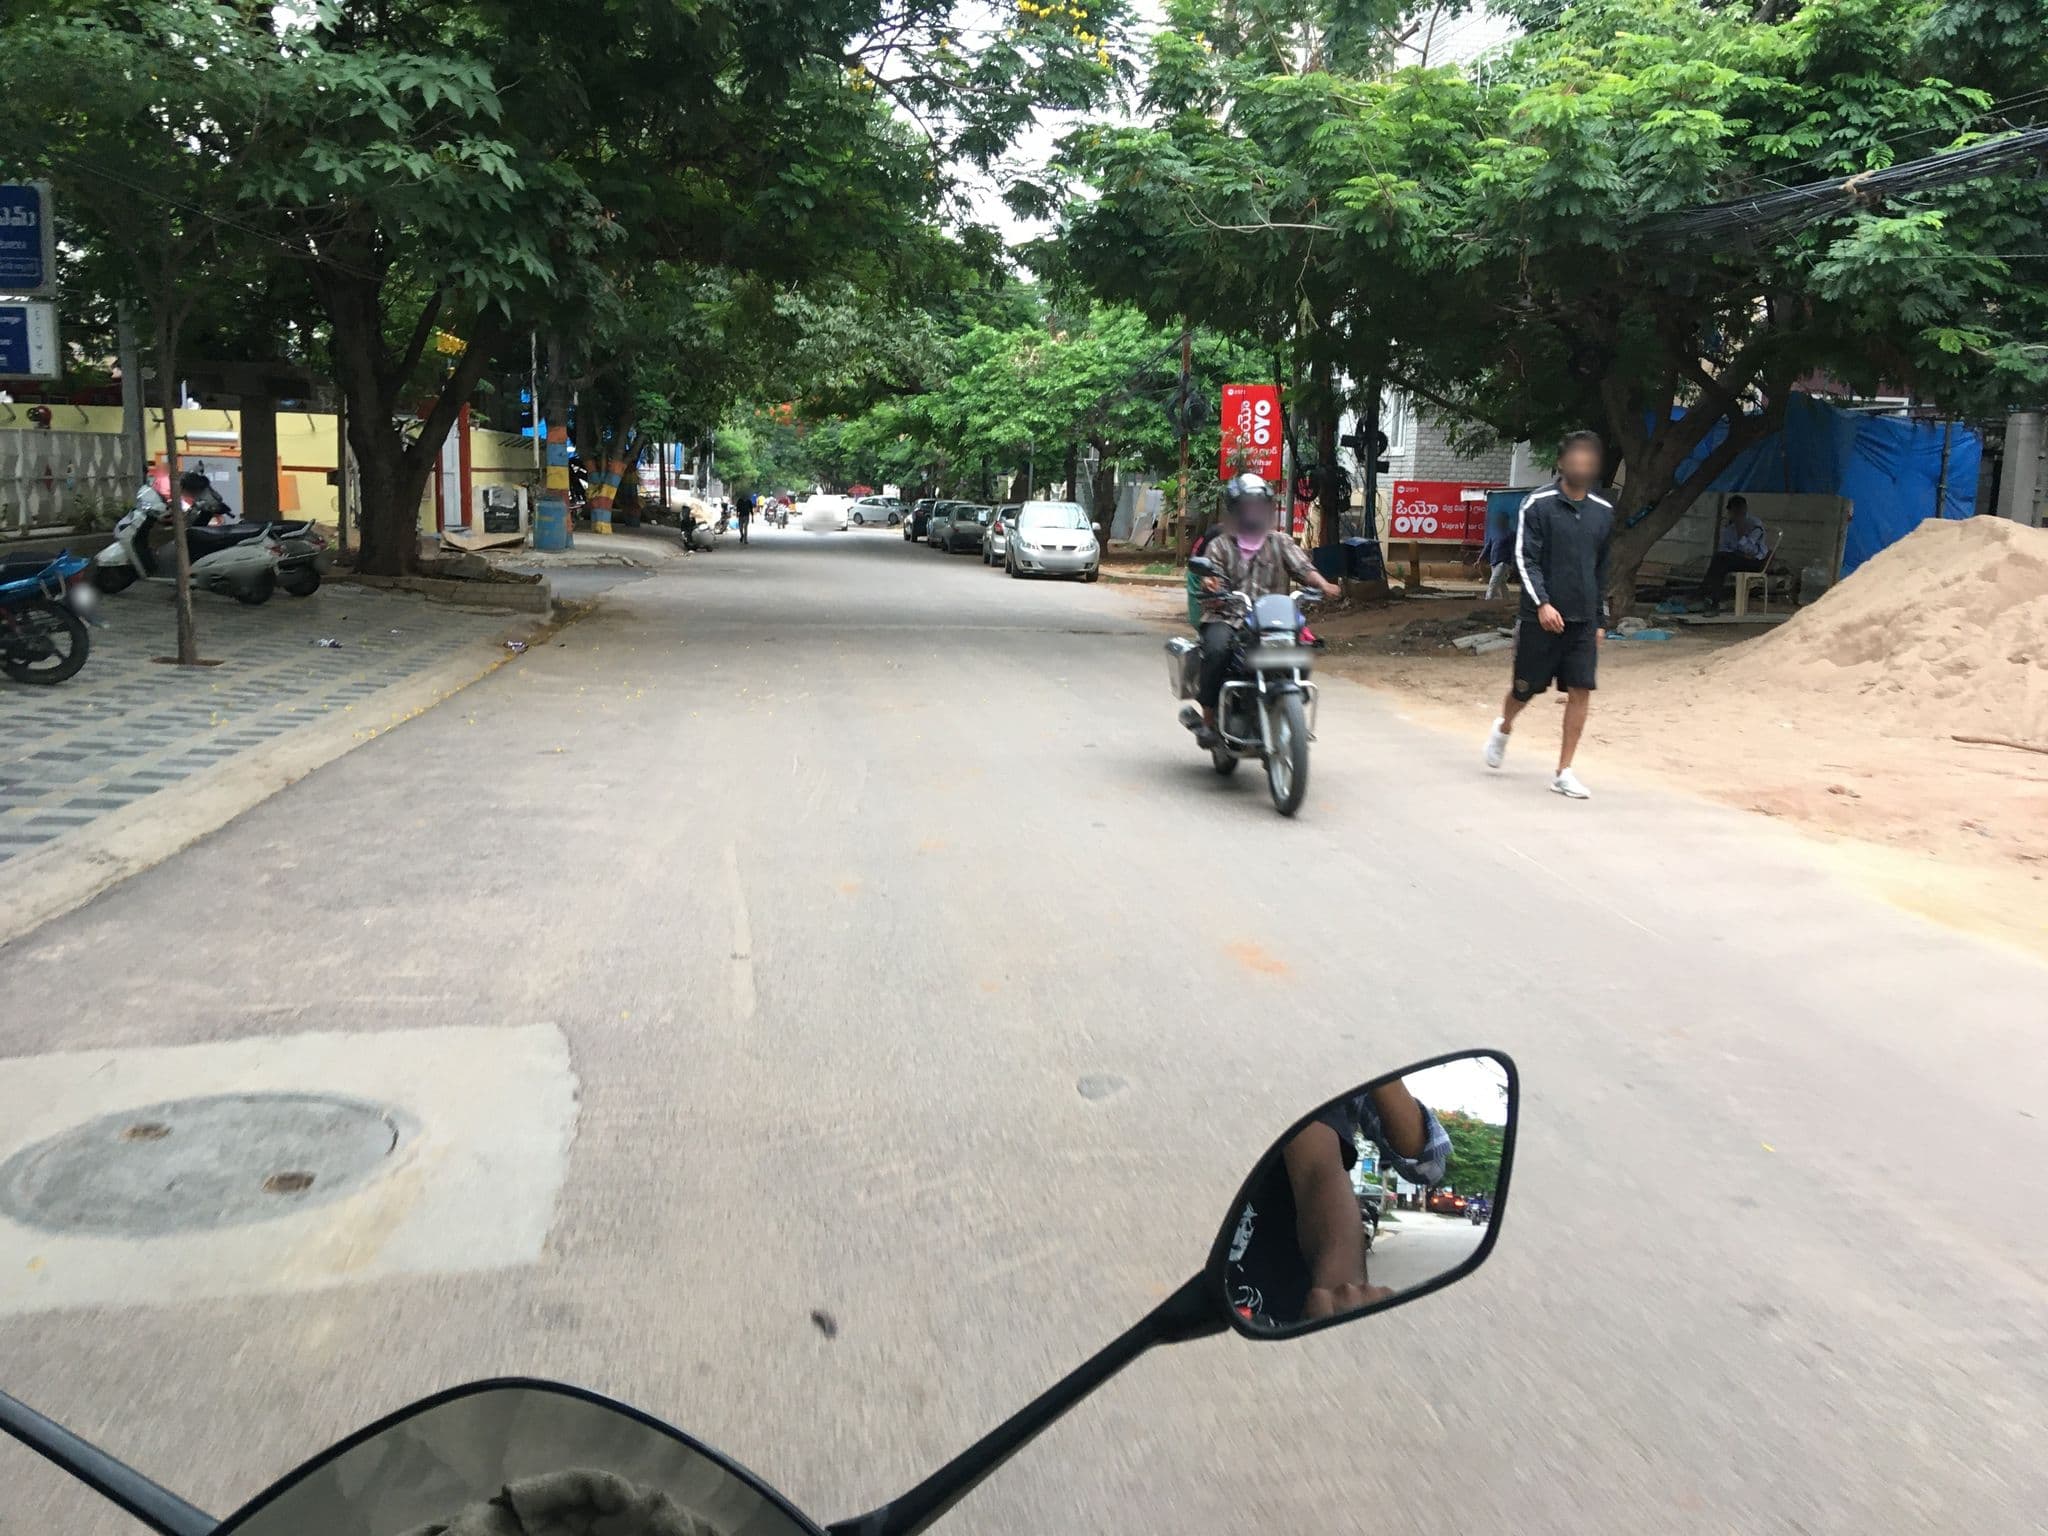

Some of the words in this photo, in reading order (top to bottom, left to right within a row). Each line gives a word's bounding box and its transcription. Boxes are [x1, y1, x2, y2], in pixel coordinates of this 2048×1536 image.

[1254, 399, 1271, 445] OYO
[1395, 499, 1439, 515] ఓయో
[1394, 516, 1438, 534] OYO
